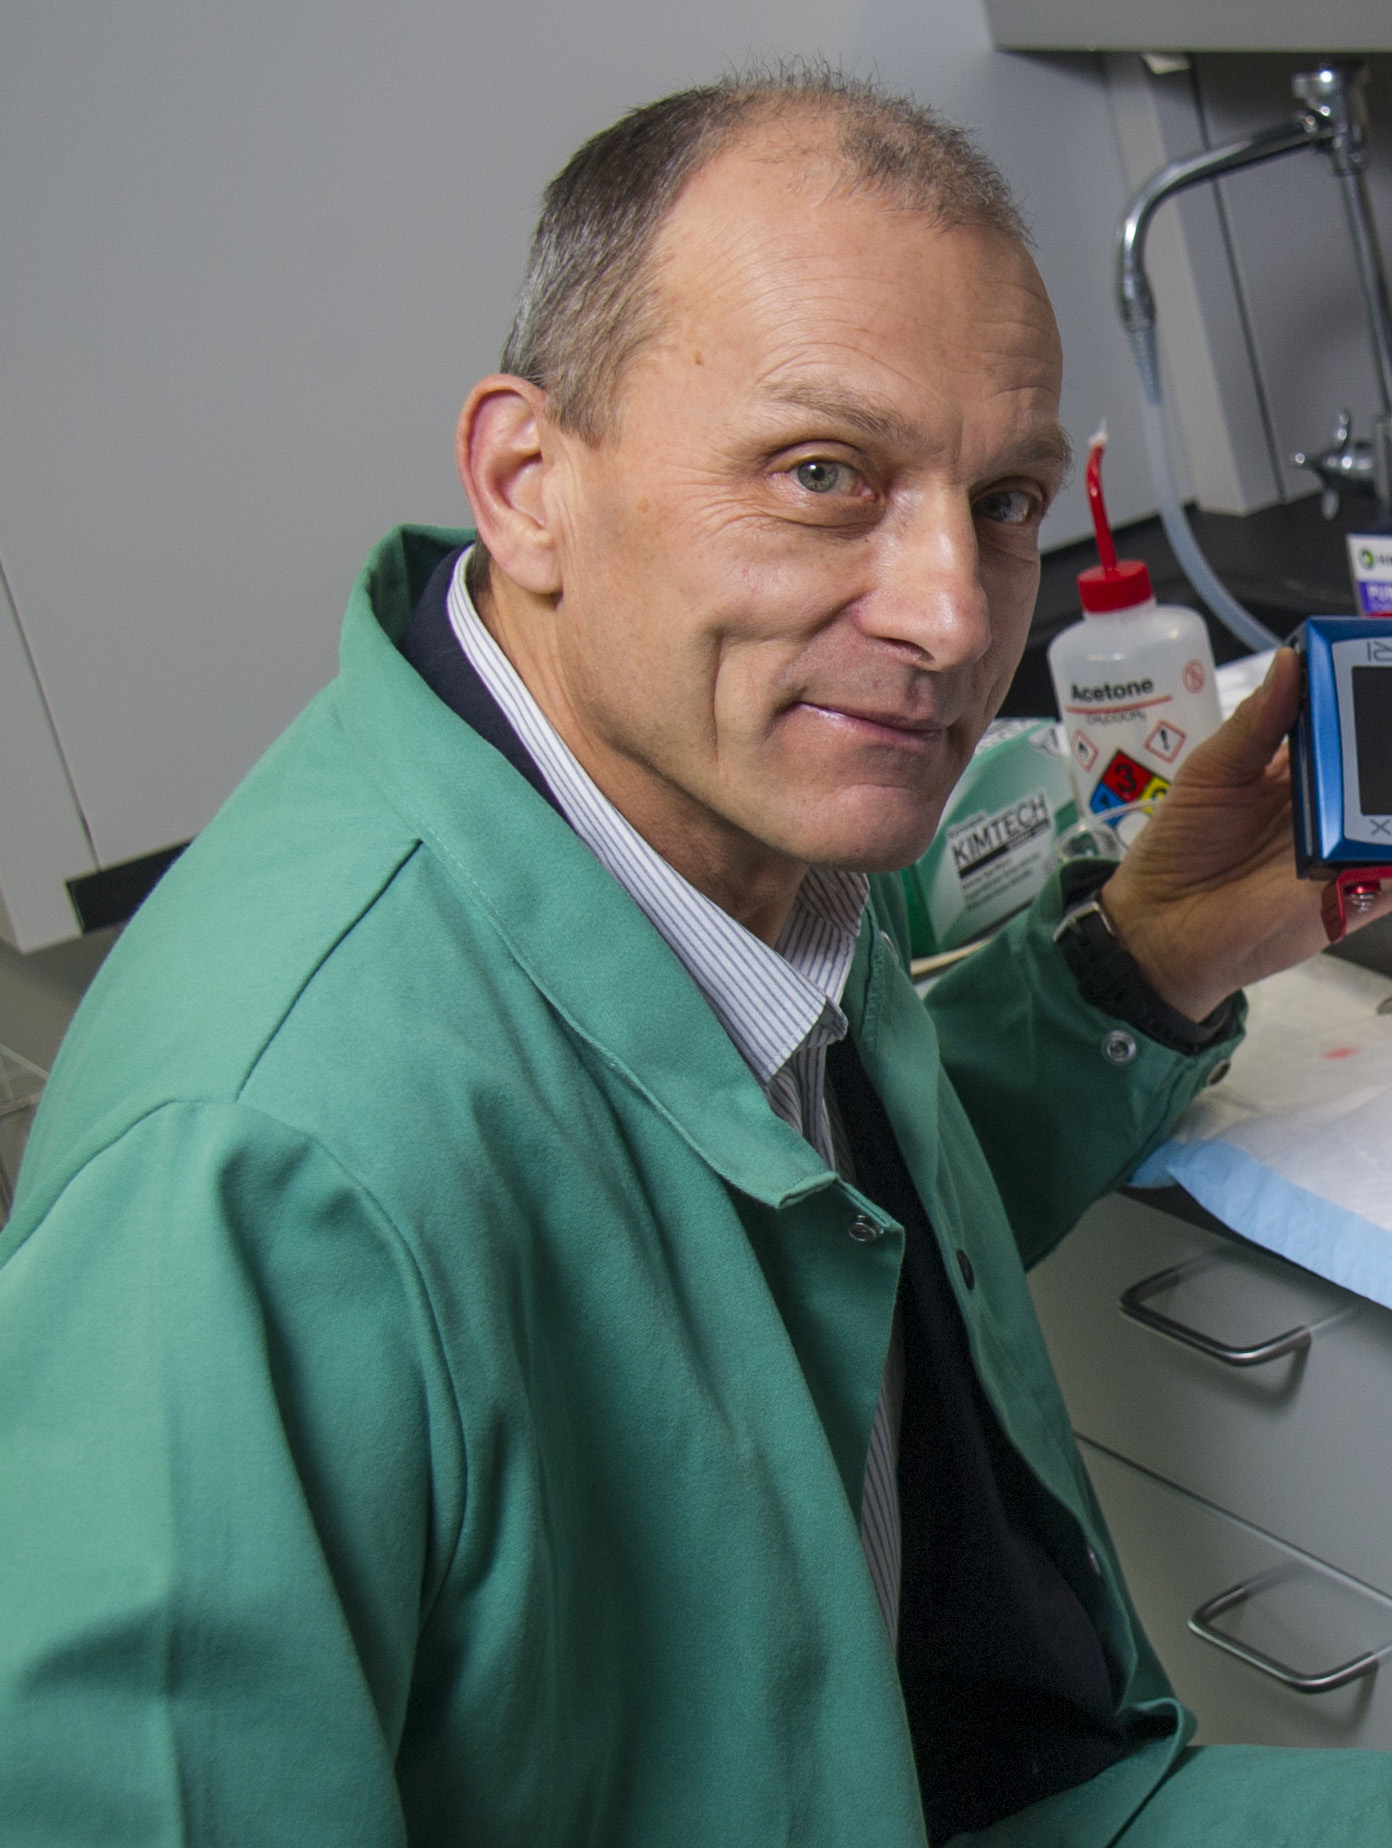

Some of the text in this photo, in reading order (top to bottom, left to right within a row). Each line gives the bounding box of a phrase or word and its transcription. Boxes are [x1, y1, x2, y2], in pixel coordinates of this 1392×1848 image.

[1072, 679, 1154, 702] Acetone
[1114, 764, 1137, 794] 3
[951, 792, 1048, 868] KIMTECH
